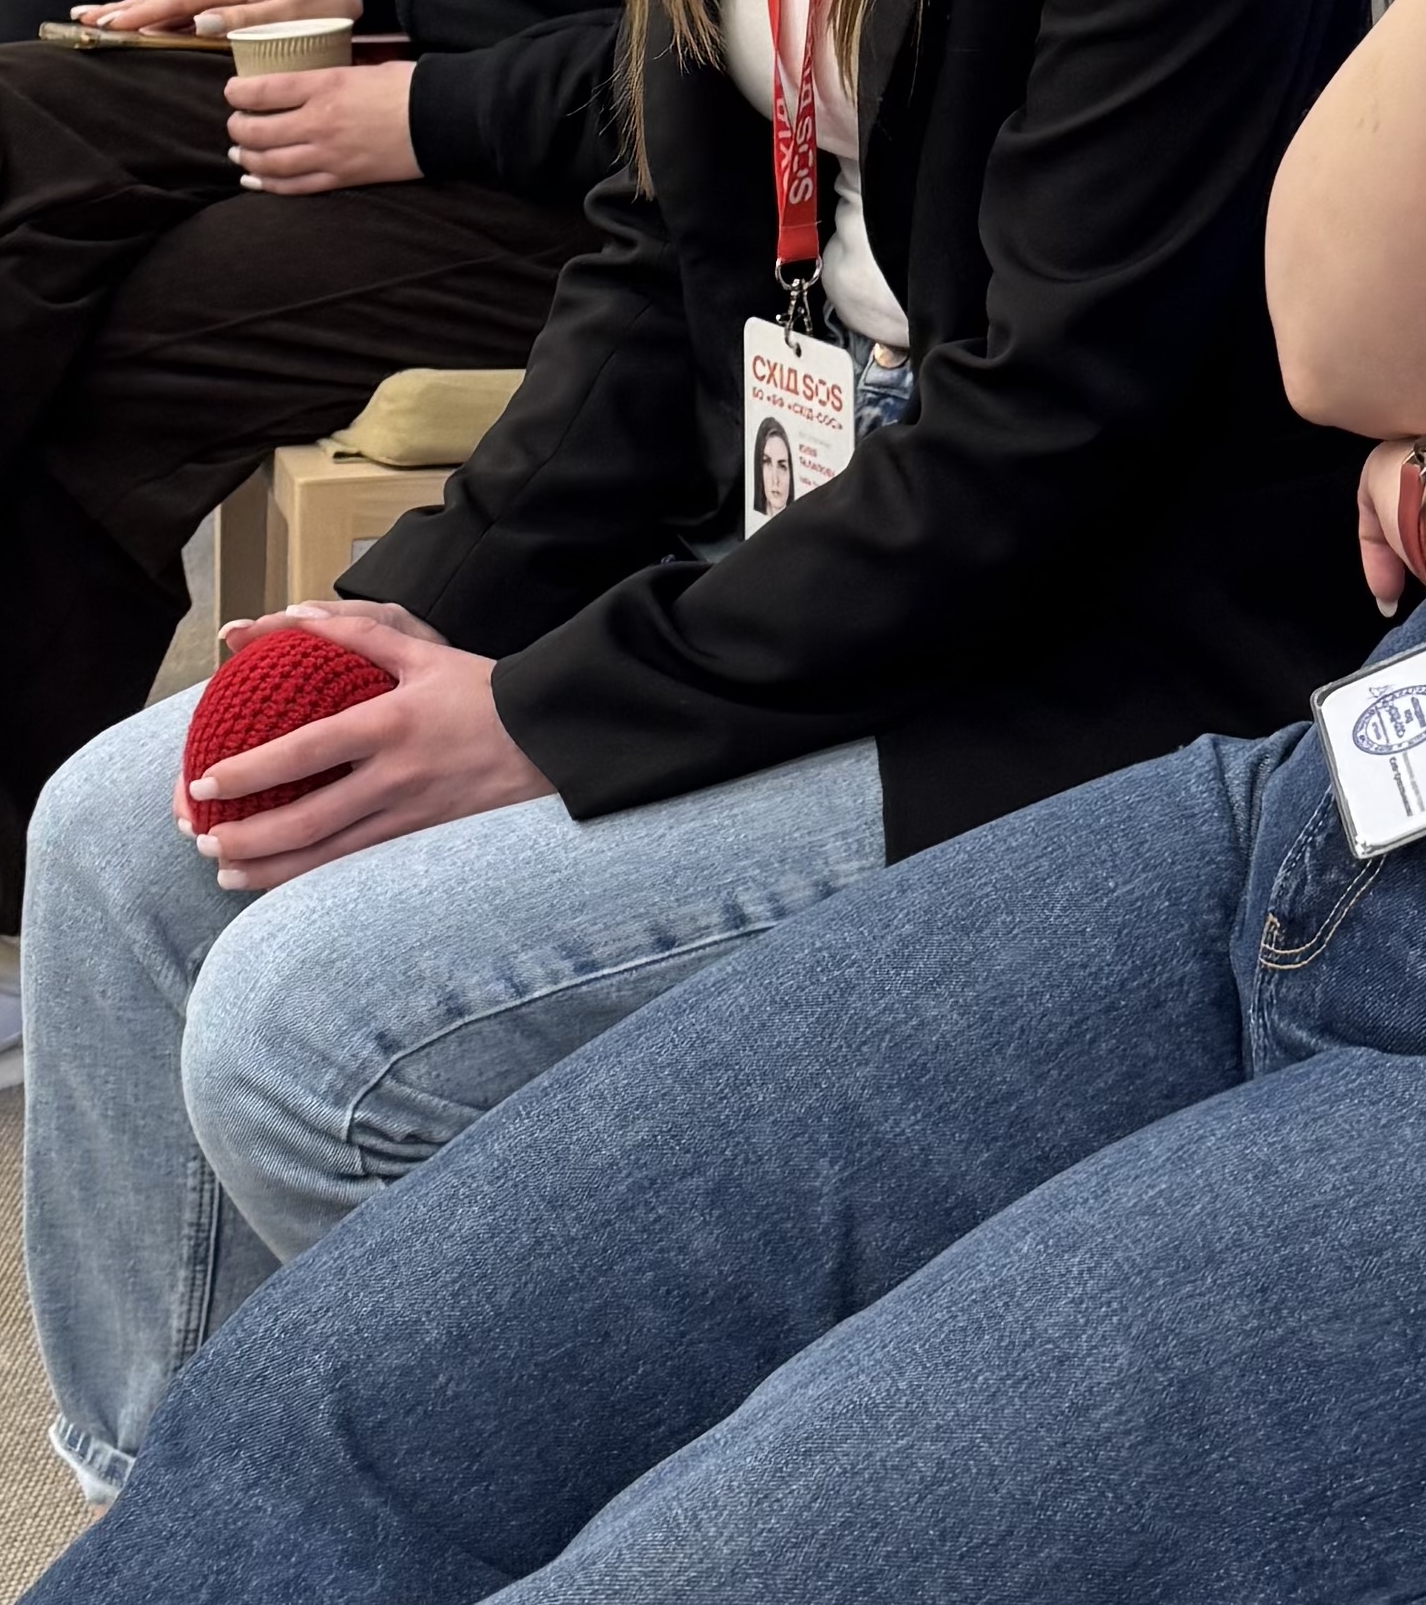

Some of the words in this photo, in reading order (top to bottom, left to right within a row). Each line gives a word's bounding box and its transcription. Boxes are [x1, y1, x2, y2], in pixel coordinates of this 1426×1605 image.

[789, 116, 815, 205] SOS
[752, 355, 800, 396] СХІД
[802, 373, 844, 413] SOS
